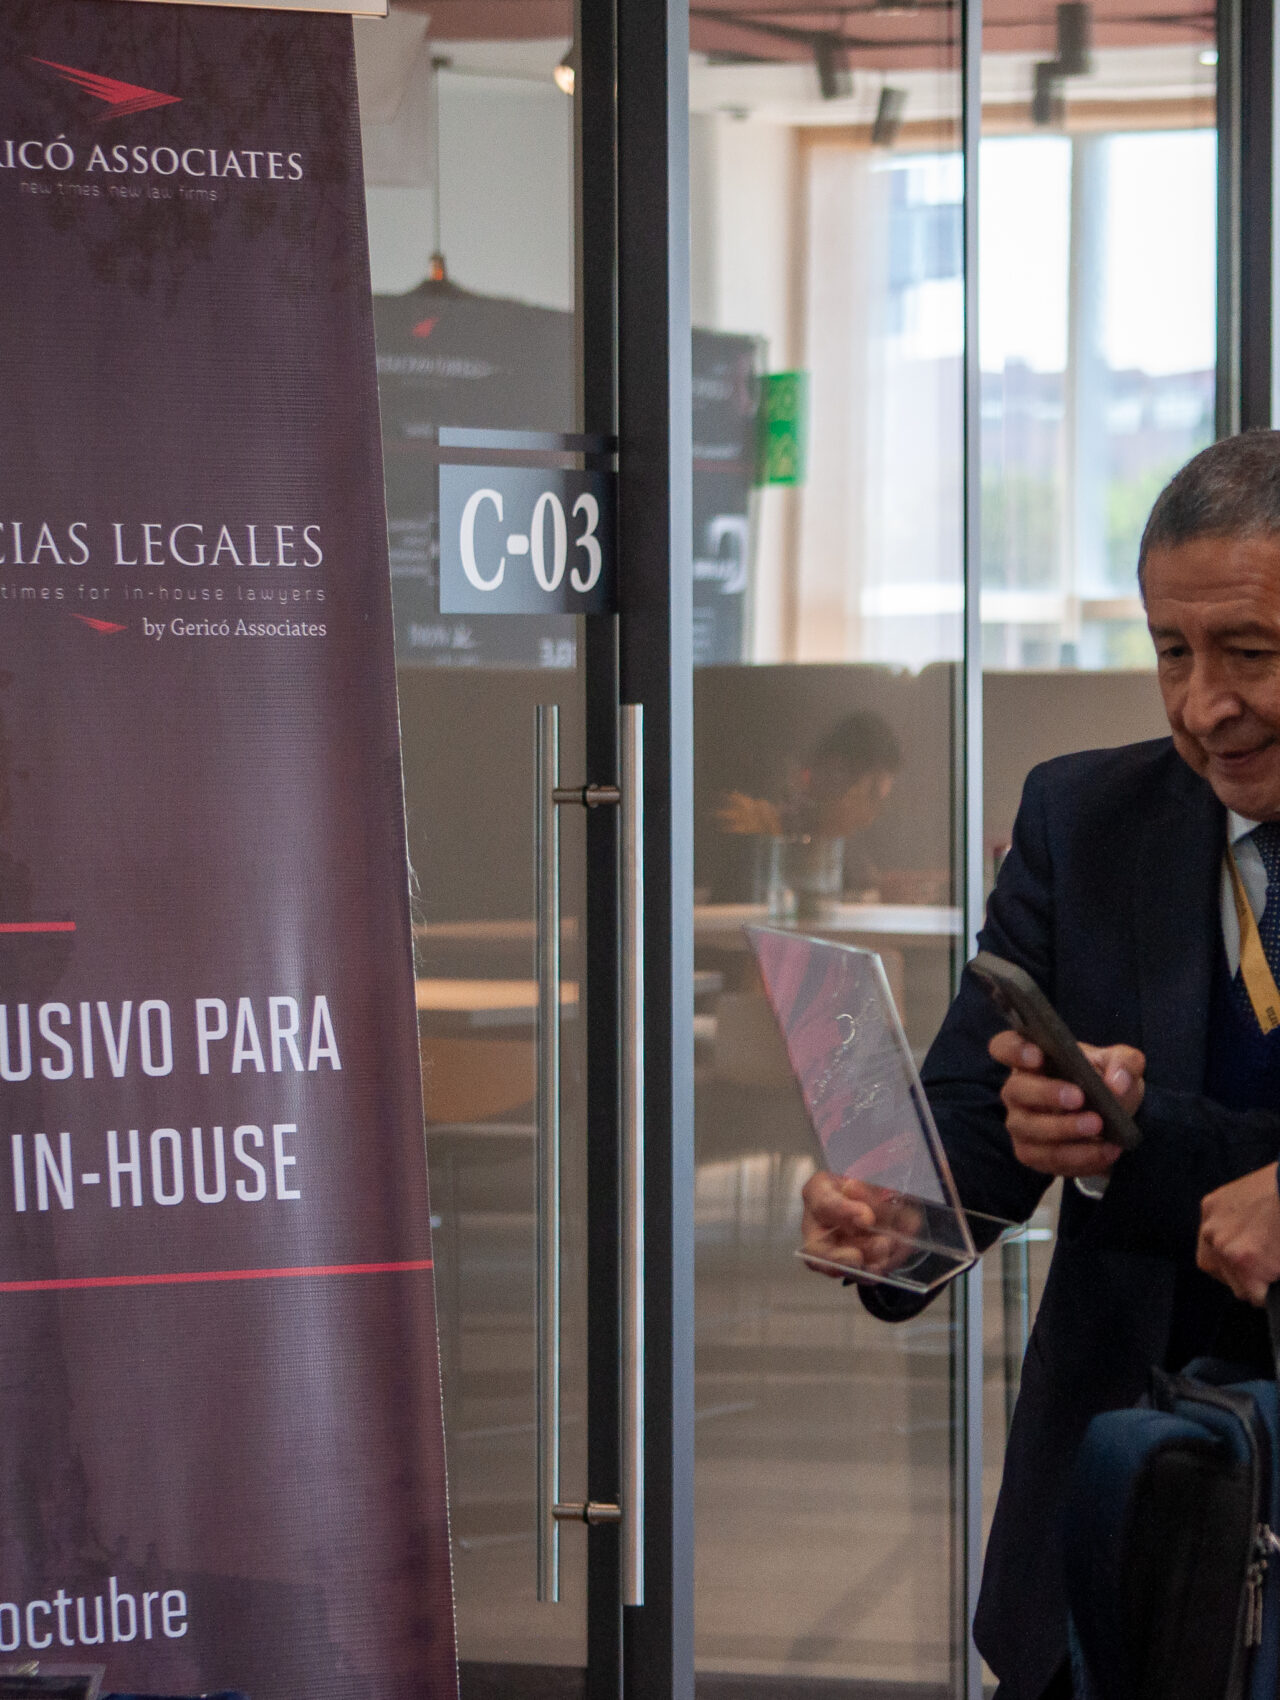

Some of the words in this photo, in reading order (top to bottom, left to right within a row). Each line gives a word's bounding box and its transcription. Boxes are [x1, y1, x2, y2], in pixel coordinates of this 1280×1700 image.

[0, 133, 75, 171] ICÓ
[86, 144, 304, 181] ASSOCIATES
[0, 522, 90, 565] IAS
[112, 523, 324, 568] LEGALES
[459, 488, 602, 593] C-03
[78, 584, 110, 599] for
[124, 585, 224, 601] in-house
[237, 585, 327, 604] lawyers
[142, 617, 165, 641] by
[170, 618, 230, 637] Gericó
[234, 620, 327, 638] Associates
[0, 999, 174, 1082] USIVO
[195, 995, 342, 1075] PARA
[11, 1123, 302, 1212] IN-HOUSE
[0, 1576, 189, 1652] octubre
